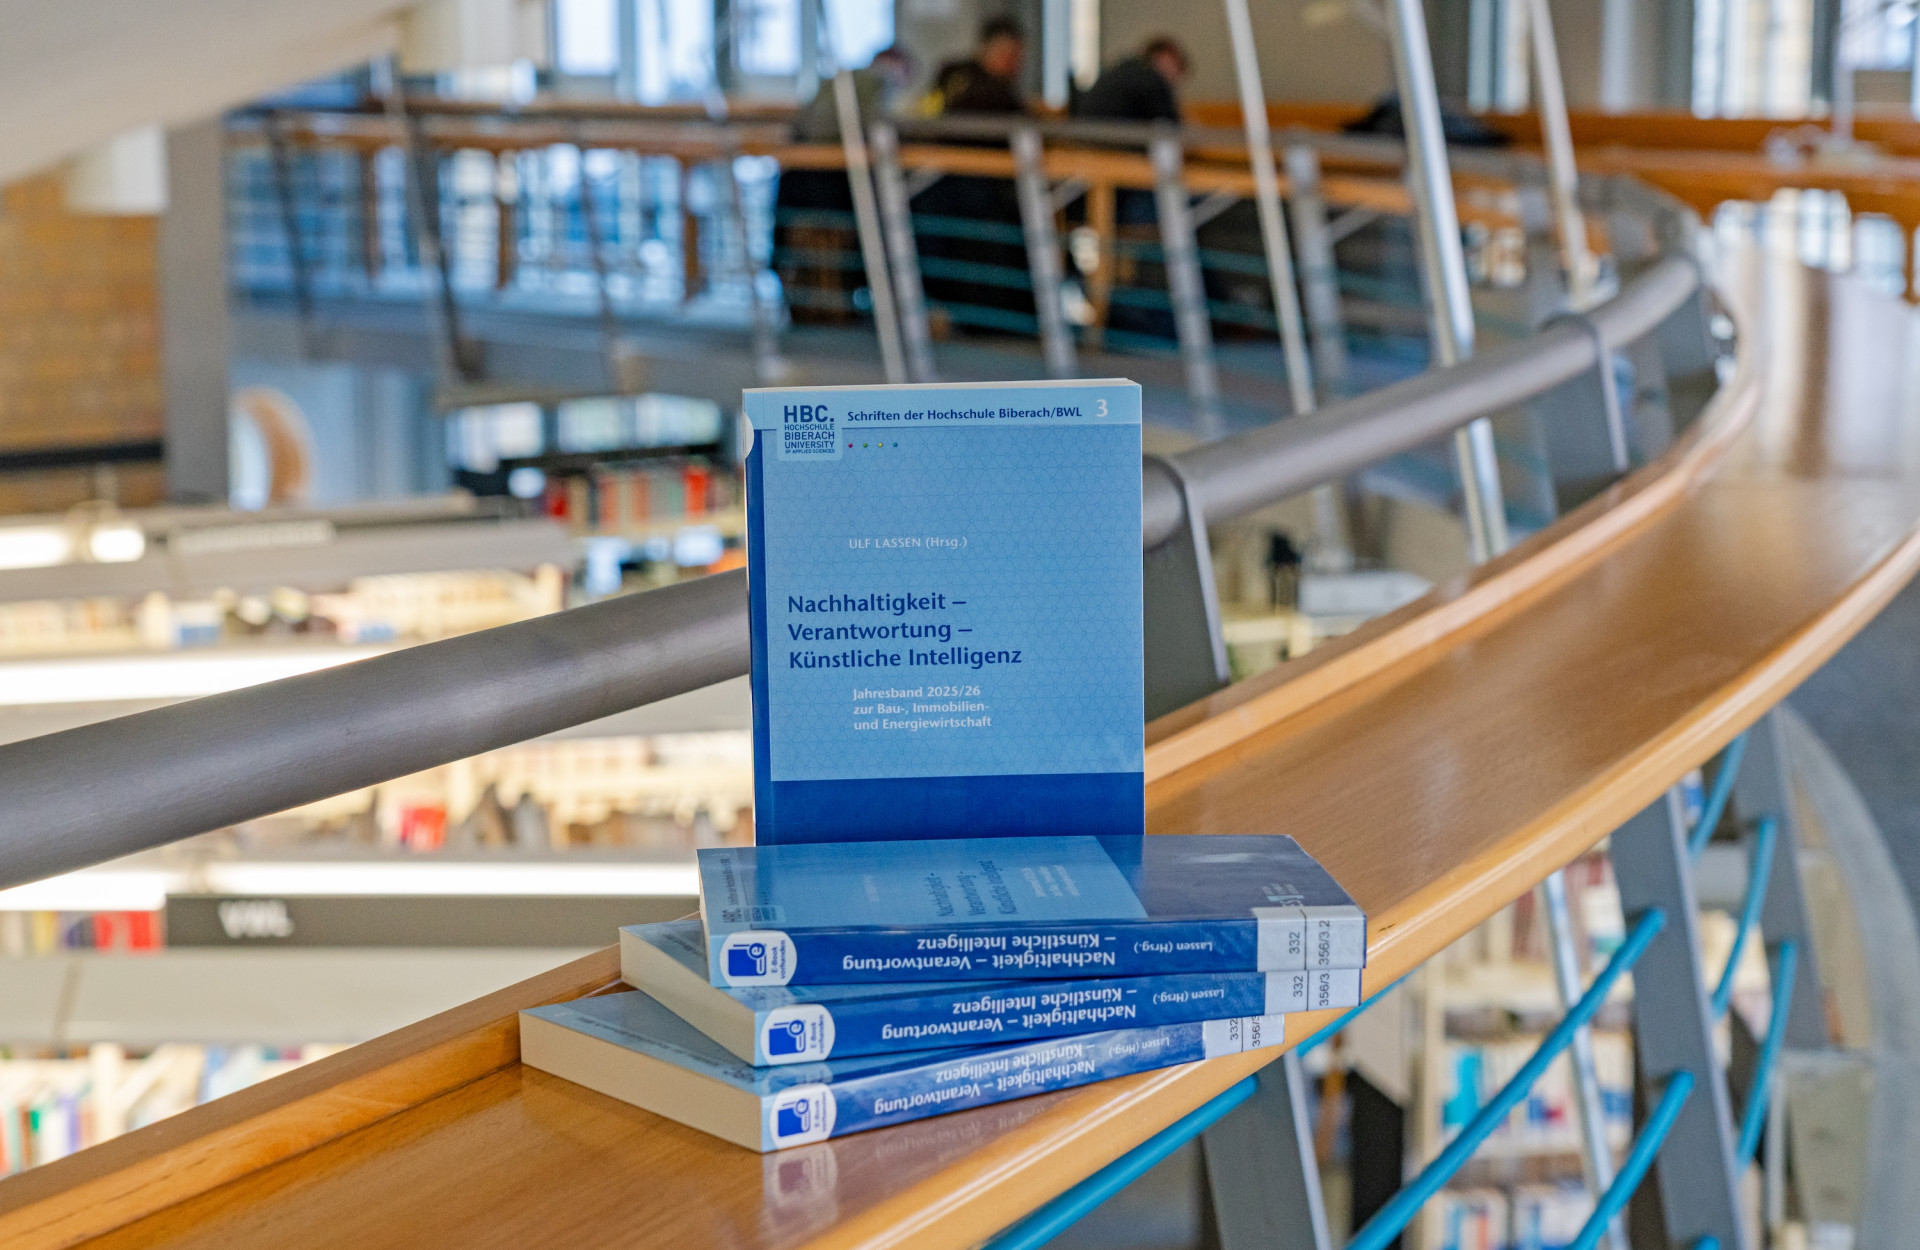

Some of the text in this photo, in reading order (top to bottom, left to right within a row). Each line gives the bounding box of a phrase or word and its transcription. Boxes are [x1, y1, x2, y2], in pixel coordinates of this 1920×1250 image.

[784, 405, 835, 423] HBC.
[847, 406, 1082, 421] Schriften der Hochschule Biberach/BWL
[1096, 399, 1108, 418] 3
[784, 423, 835, 431] HOCHSCHULE
[784, 431, 835, 440] BIBERACH
[784, 440, 835, 449] UNIVERSITY
[849, 536, 968, 550] ULF LASSEN (Hrsg.)
[788, 592, 946, 616] Nachhaltigkeit
[788, 622, 951, 642] Verantwortung
[789, 647, 1022, 670] Künstliche Intelligenz
[852, 685, 981, 701] Jahresband 2025/26
[853, 701, 990, 716] zur Bau-, Immobilien-
[854, 716, 992, 732] und Energiewirtschaft
[917, 933, 1006, 952] Intelligenz
[1011, 933, 1100, 948] Künstliche
[1133, 941, 1213, 953] Lassen (Hrsg.)
[1289, 931, 1300, 955] 332
[842, 954, 972, 971] Verantwortung
[992, 951, 1116, 969] Nachhaltigkeit
[1293, 975, 1304, 998] 332
[952, 995, 1036, 1015] Intelligenz
[1041, 987, 1122, 1006] Künstliche
[1152, 989, 1225, 1005] Lassen (Hrsg.)
[1022, 1004, 1137, 1028] Nachhaltigkeit
[882, 1017, 1004, 1040] Verantwortung
[1229, 1018, 1239, 1041] 332
[1013, 1043, 1083, 1068] Künstliche
[1109, 1037, 1170, 1058] Lassen (Hrsg.)
[936, 1055, 1008, 1083] Intelligenz
[997, 1059, 1095, 1091] Nachhaltigkeit
[874, 1083, 981, 1115] Verantwortung
